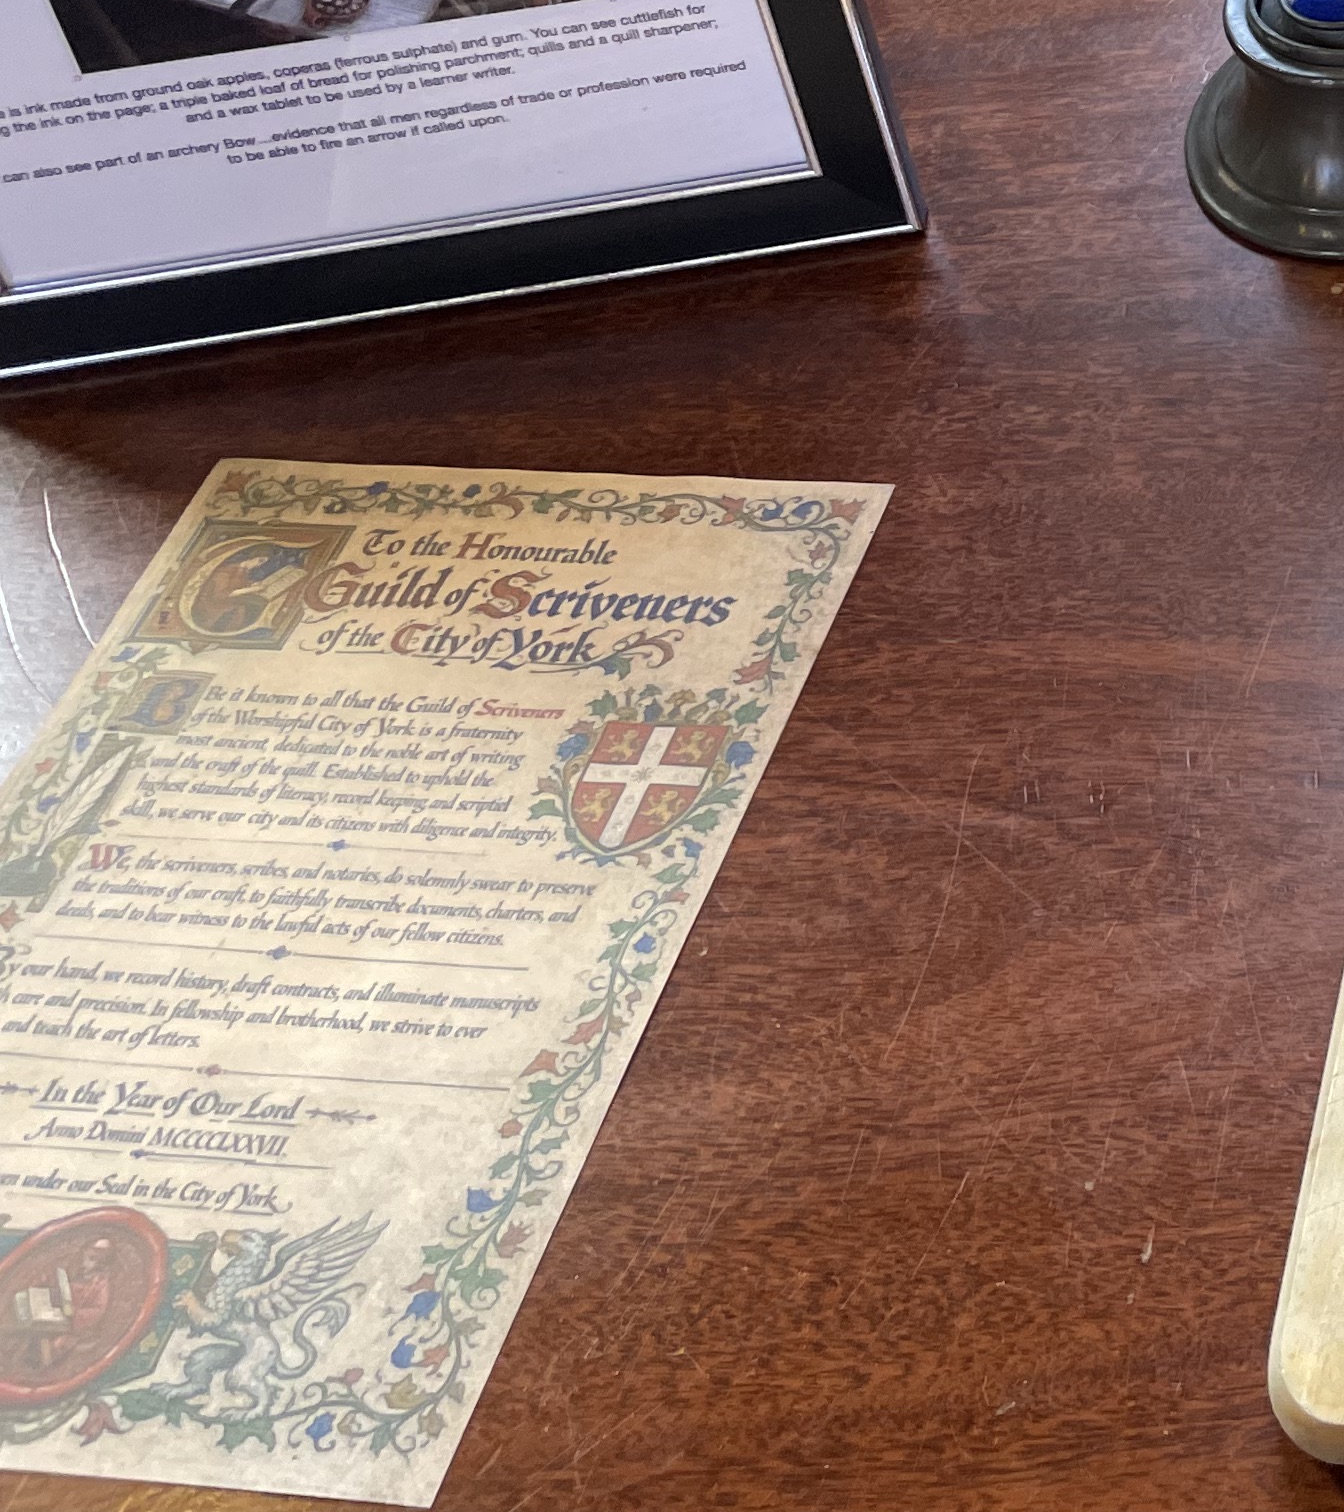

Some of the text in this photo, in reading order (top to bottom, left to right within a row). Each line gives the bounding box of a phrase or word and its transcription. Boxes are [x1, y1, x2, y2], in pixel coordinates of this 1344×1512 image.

[226, 115, 509, 165] to be able to fire an arrow if called upon.
[363, 528, 618, 565] To the Honourable
[304, 561, 738, 627] Guild of Scriveners
[318, 619, 602, 670] of the City of York
[38, 1077, 304, 1120] In the Year of Our Lord
